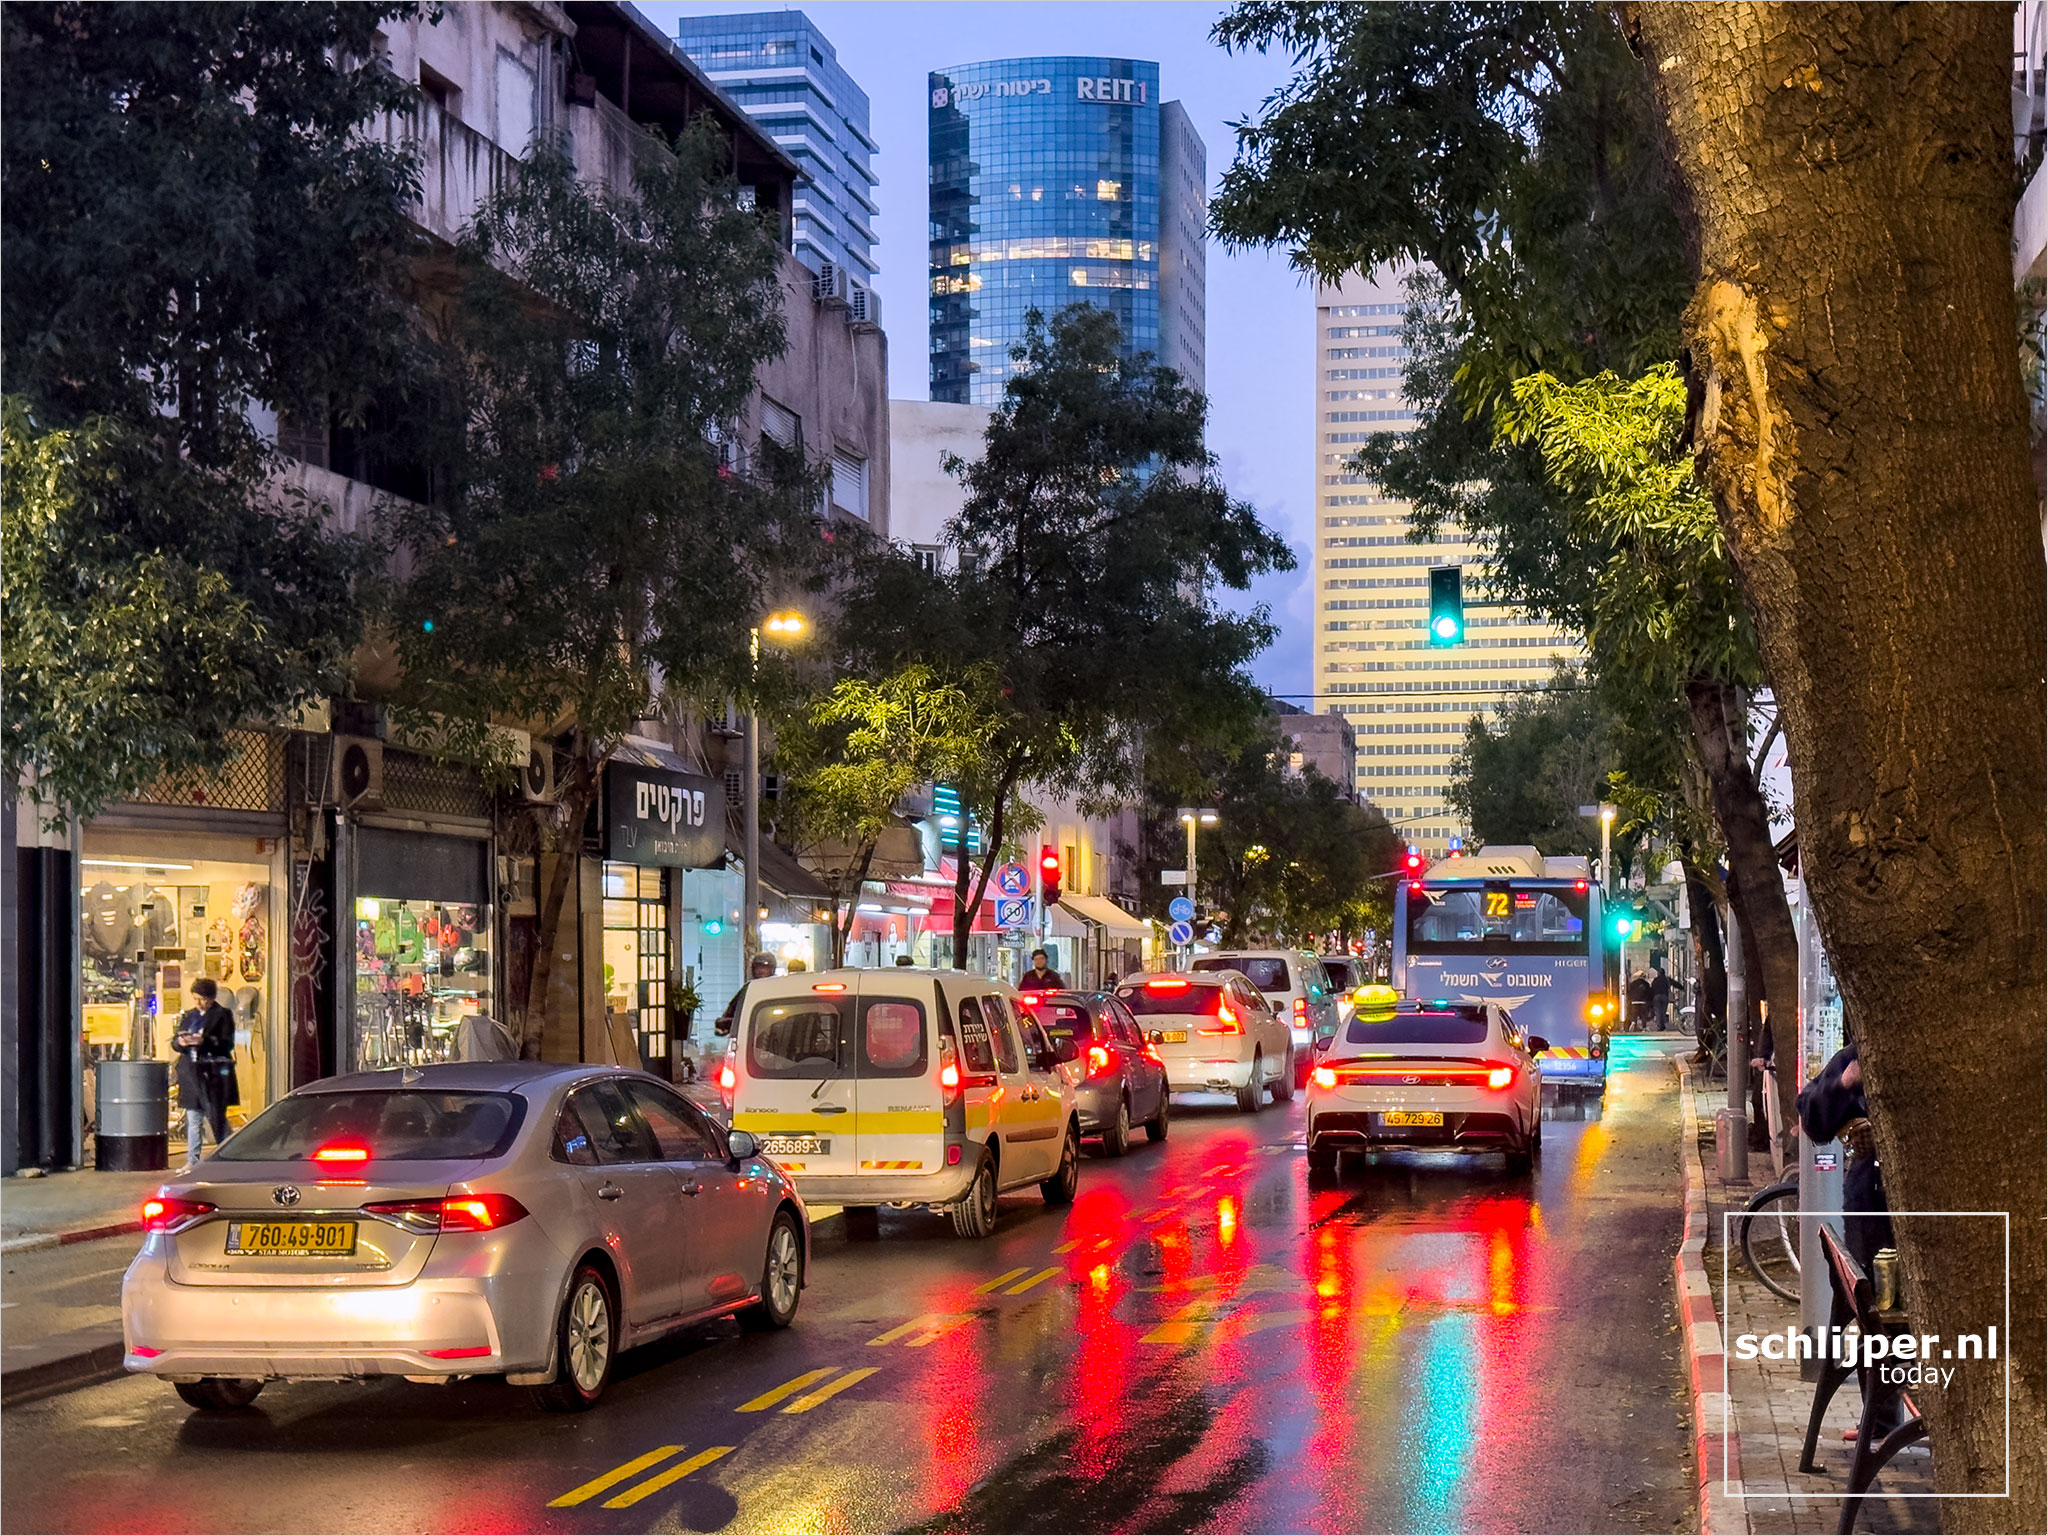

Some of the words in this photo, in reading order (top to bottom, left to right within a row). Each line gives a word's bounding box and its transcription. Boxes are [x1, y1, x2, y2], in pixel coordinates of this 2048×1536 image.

[951, 83, 990, 102] ישיר
[995, 78, 1052, 98] ביטוח
[1077, 77, 1135, 102] REIT
[636, 781, 705, 835] פרקטים
[1006, 907, 1021, 917] 30
[1486, 892, 1509, 916] 72
[1554, 960, 1588, 968] HIGER
[1440, 970, 1479, 987] חשמלי
[1506, 973, 1553, 988] אוטובוס
[963, 1023, 985, 1034] ניידת
[963, 1033, 987, 1044] שירות
